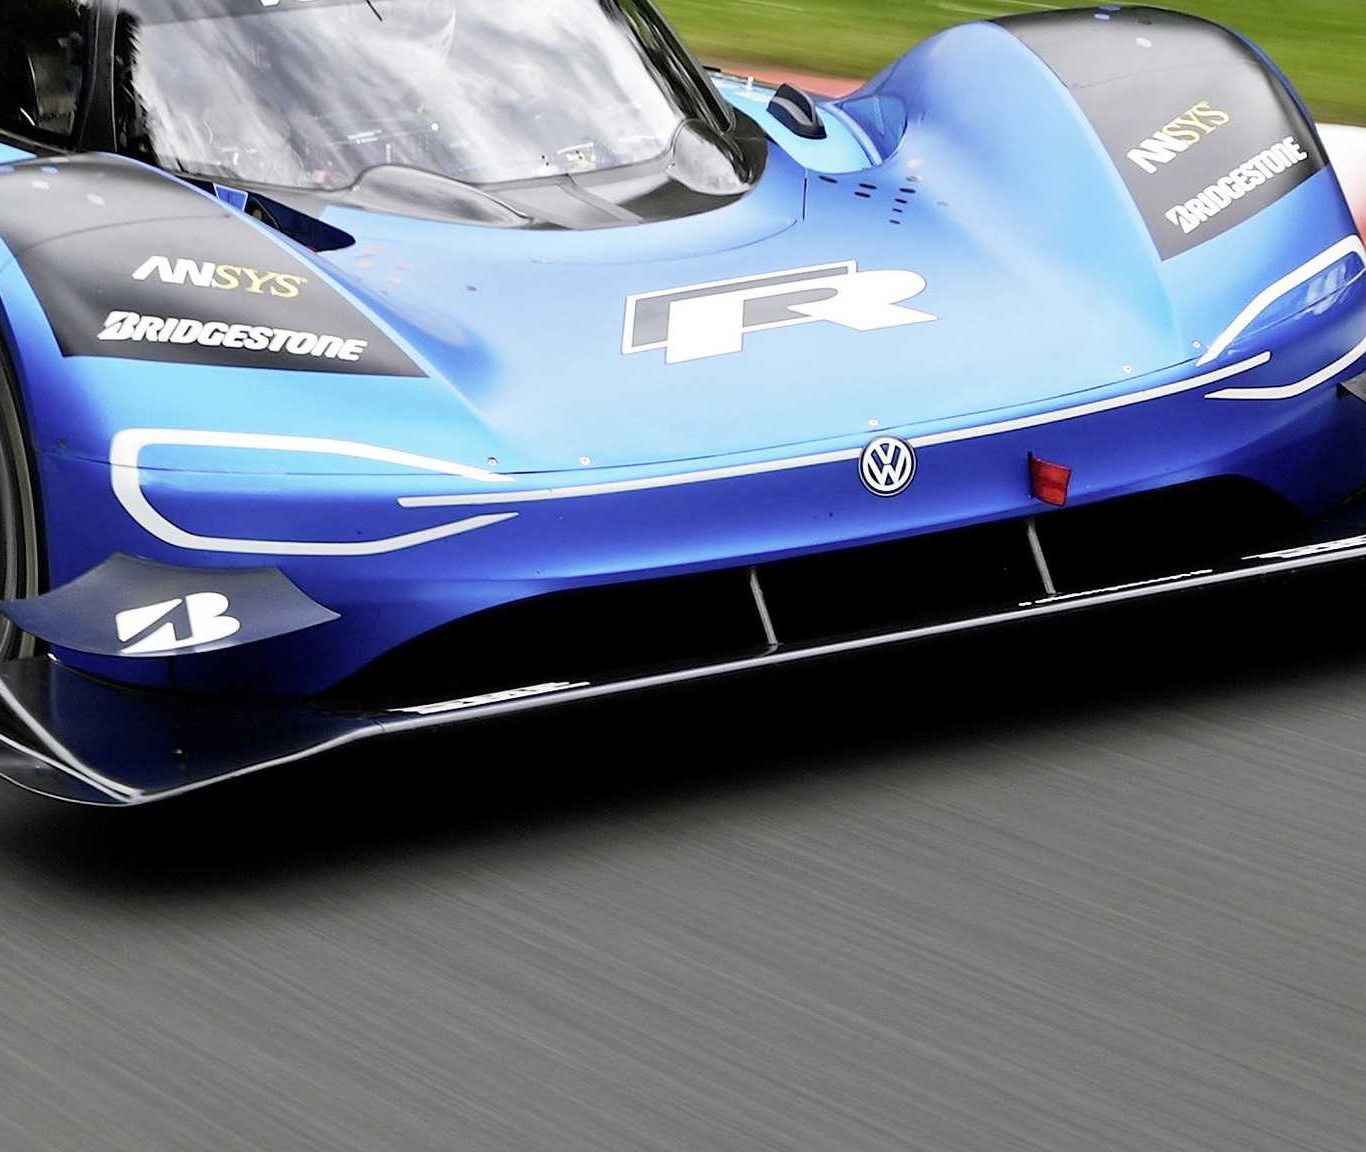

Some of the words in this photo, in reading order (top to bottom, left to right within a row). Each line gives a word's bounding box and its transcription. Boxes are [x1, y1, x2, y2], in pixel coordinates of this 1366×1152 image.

[1127, 101, 1230, 174] ANSYS
[1165, 136, 1308, 234] BRIDGESTONE
[132, 255, 302, 298] ANSYS
[97, 311, 368, 361] BRIDGESTONE
[858, 436, 917, 497] VW
